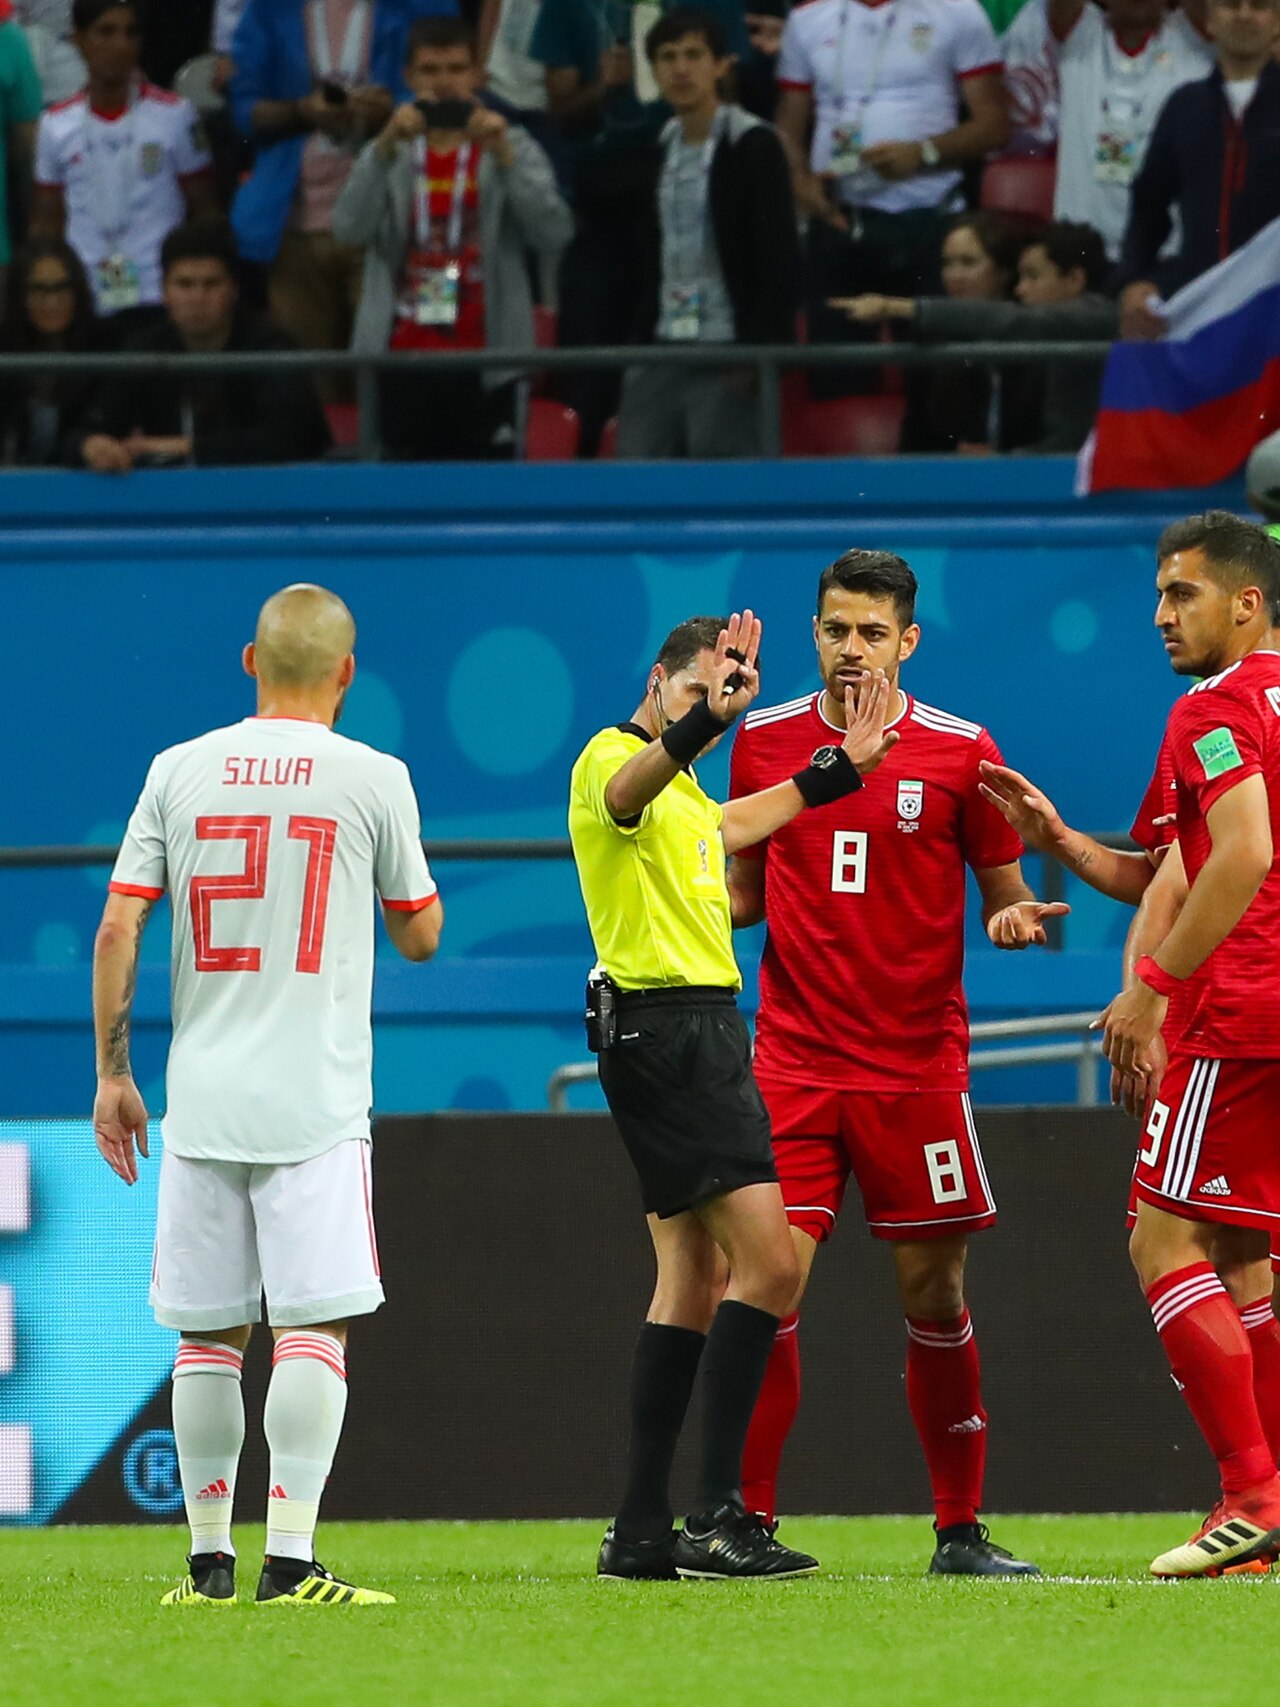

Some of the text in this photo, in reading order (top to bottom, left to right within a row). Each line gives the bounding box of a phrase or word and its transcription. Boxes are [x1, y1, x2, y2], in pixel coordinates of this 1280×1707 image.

[222, 757, 314, 785] SILVA
[831, 830, 868, 894] 8
[189, 815, 338, 975] 21
[923, 1139, 967, 1204] 8
